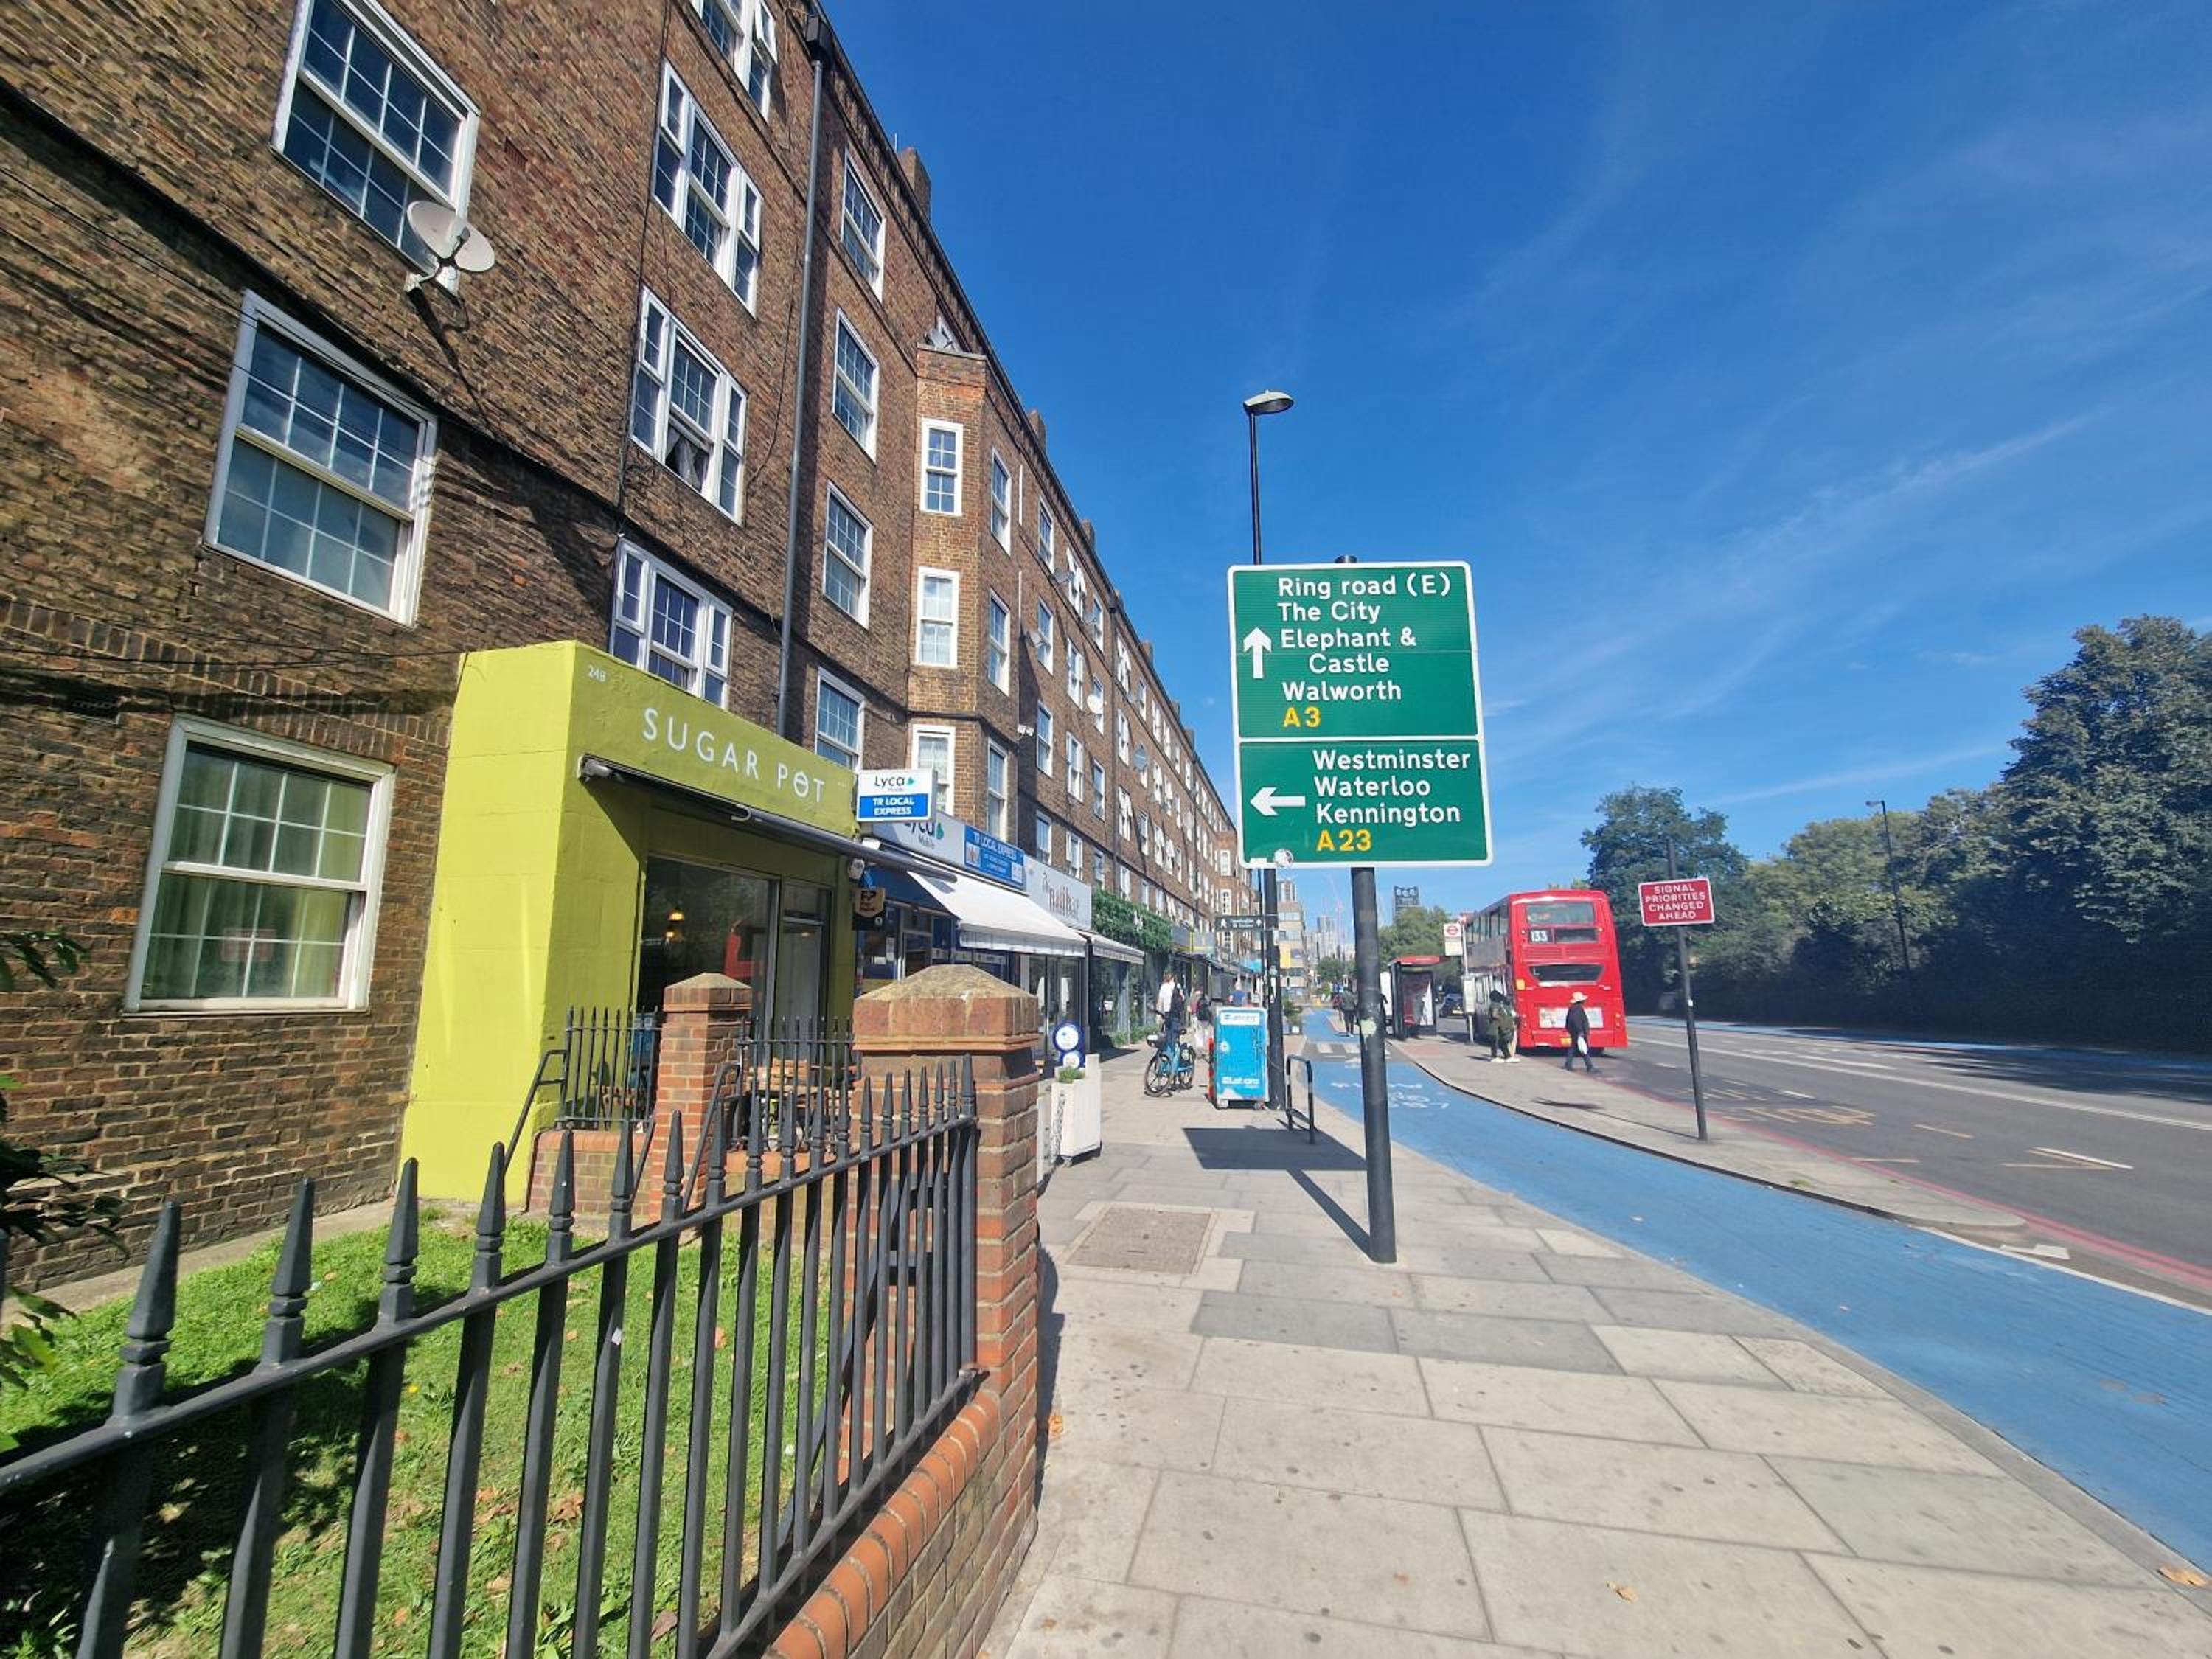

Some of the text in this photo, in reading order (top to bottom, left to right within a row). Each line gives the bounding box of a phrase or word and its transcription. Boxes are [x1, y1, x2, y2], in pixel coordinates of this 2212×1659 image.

[1279, 572, 1450, 599] Ring road (E)
[1278, 601, 1380, 623] The City
[1281, 627, 1416, 651] Elephant &
[1310, 653, 1388, 673] Castle
[1283, 681, 1401, 700] Walworth
[1284, 706, 1320, 727] A3
[642, 708, 825, 803] SUGAR POT
[1313, 749, 1470, 770] Westminster
[874, 776, 905, 788] Lyca
[1315, 776, 1430, 796] Waterloo
[873, 797, 914, 806] TR LOCAL
[874, 807, 912, 815] EXPRESS
[1317, 803, 1460, 827] Kennington
[1318, 830, 1371, 851] A23
[1645, 892, 1705, 903] PRIORITIES
[1654, 883, 1695, 894] SIGNAL
[1649, 901, 1704, 912] CHANGED
[1658, 911, 1697, 920] AHEAD
[1530, 930, 1548, 942] 133
